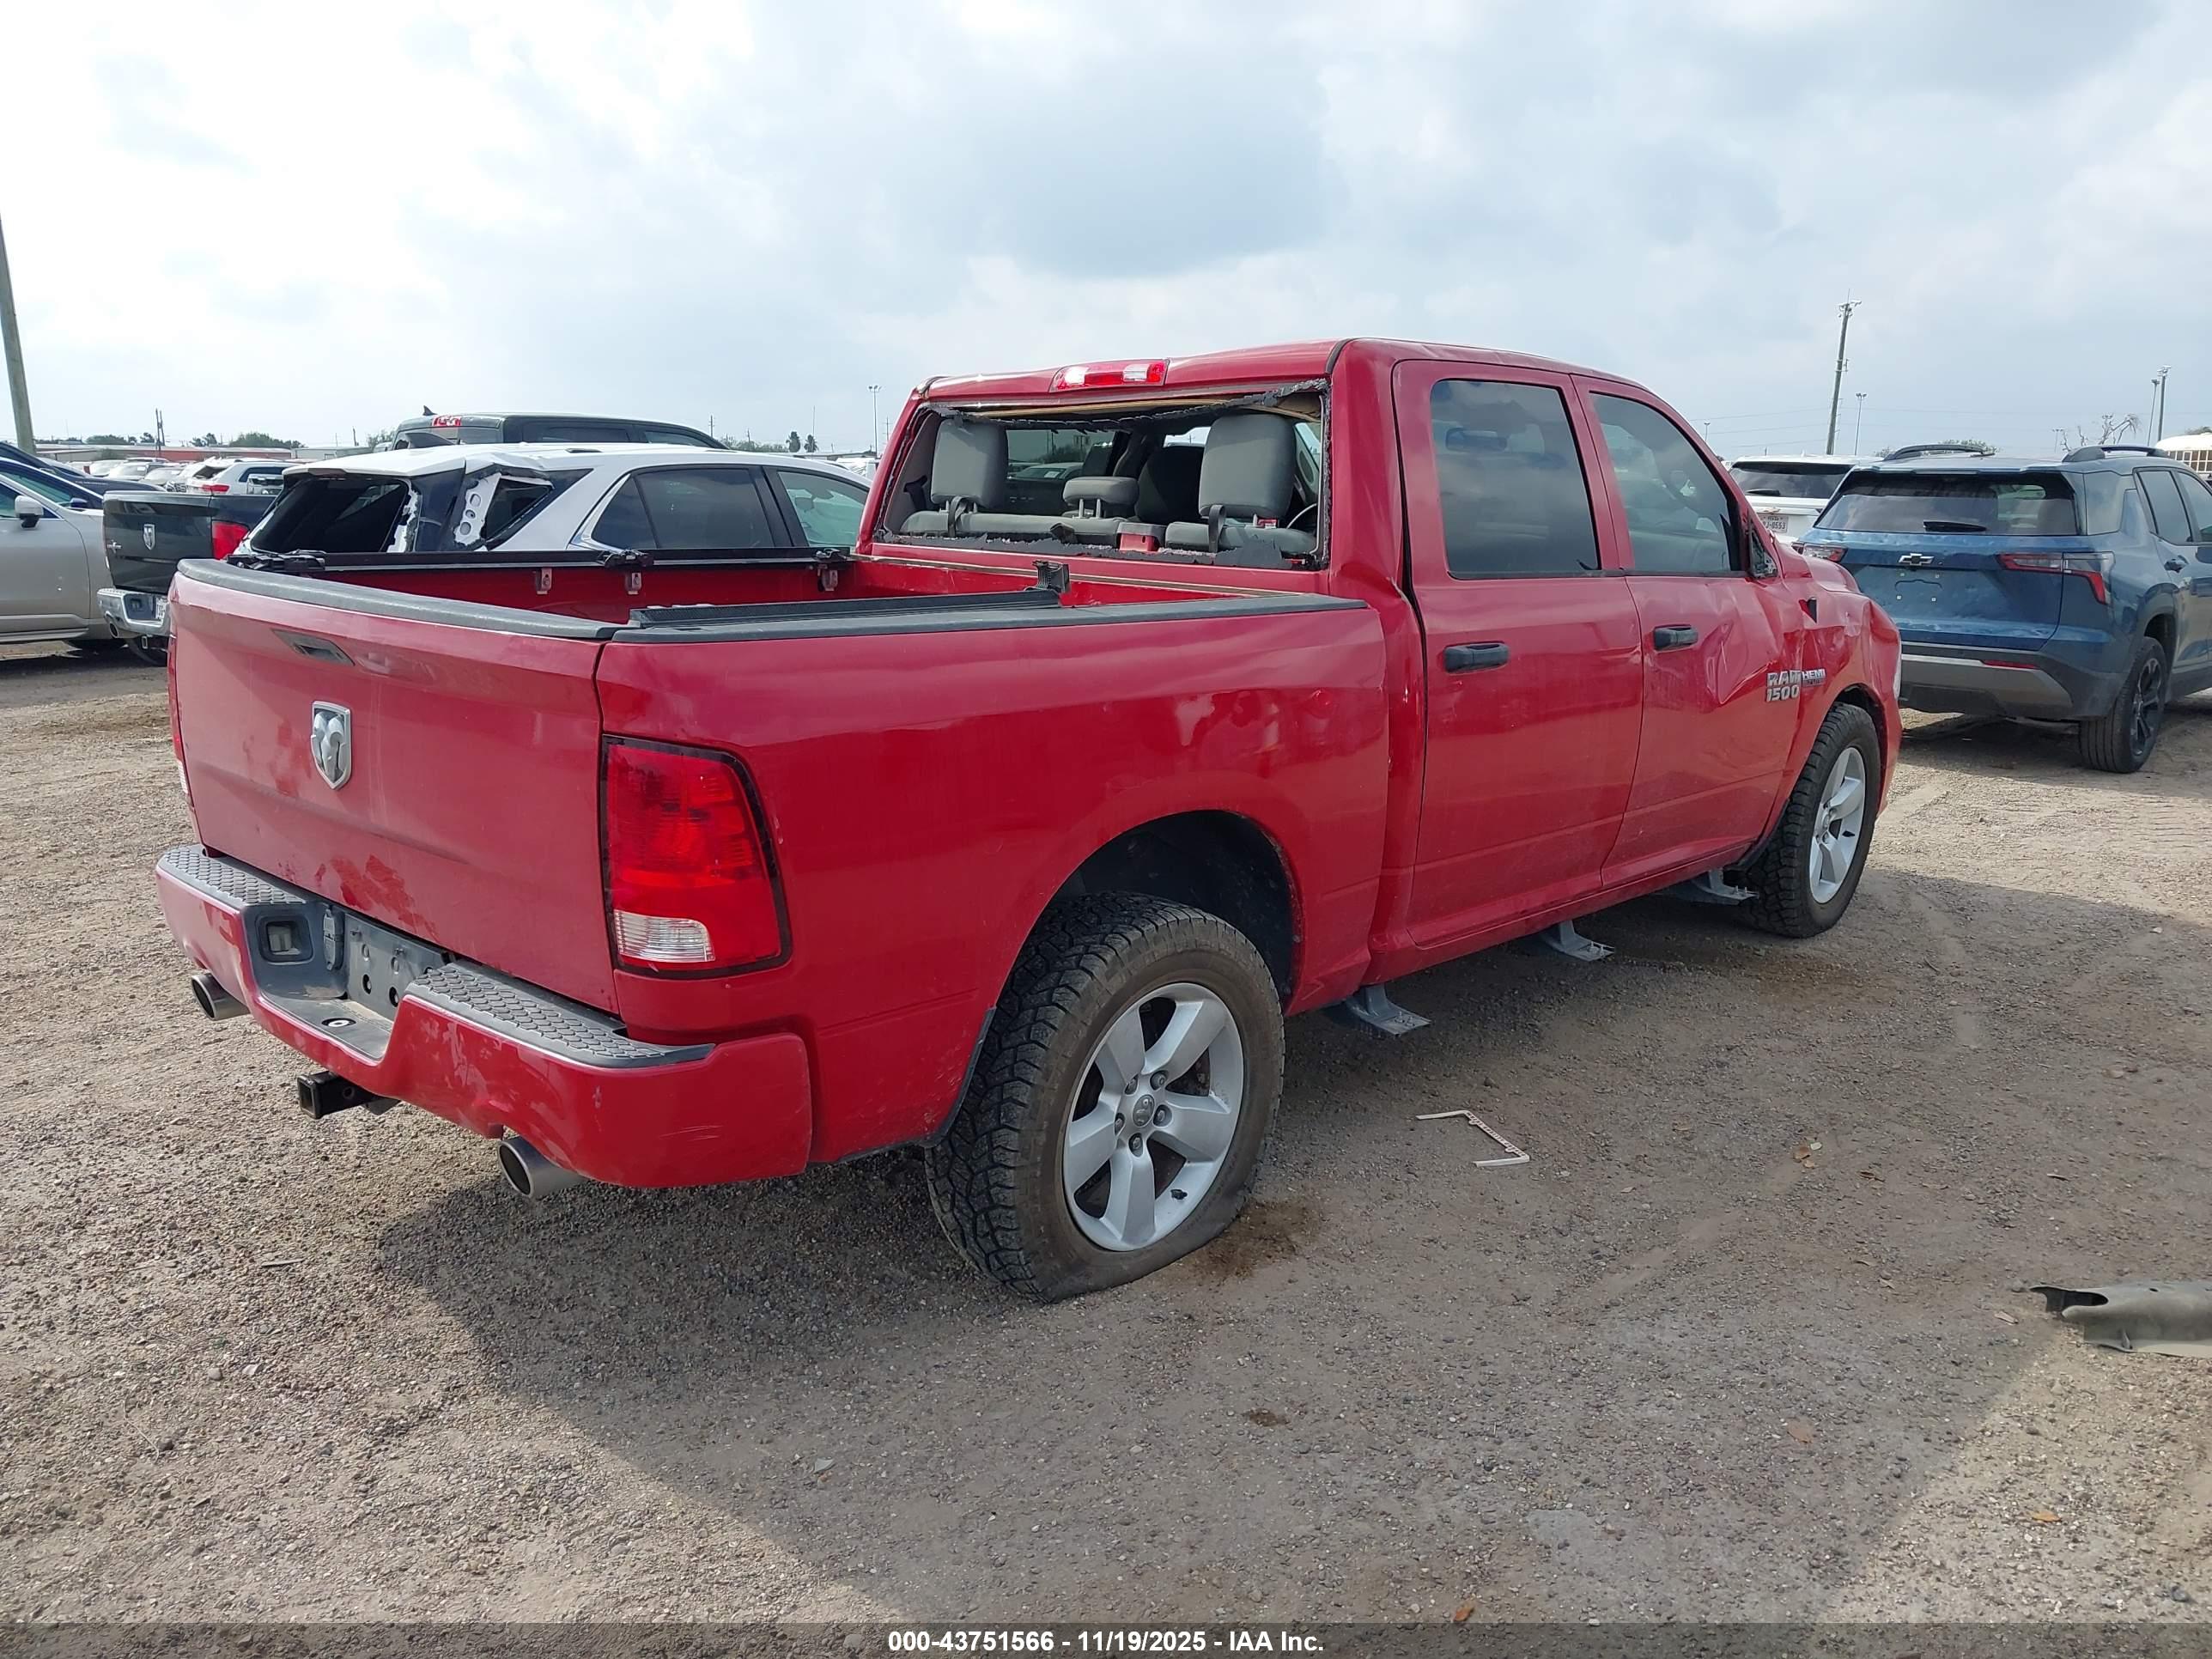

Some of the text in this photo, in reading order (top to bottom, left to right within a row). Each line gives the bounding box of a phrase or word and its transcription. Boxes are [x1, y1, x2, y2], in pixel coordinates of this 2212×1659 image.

[1767, 670, 1802, 687] RAM
[1802, 669, 1826, 681] HEMI
[1766, 684, 1800, 702] 1500
